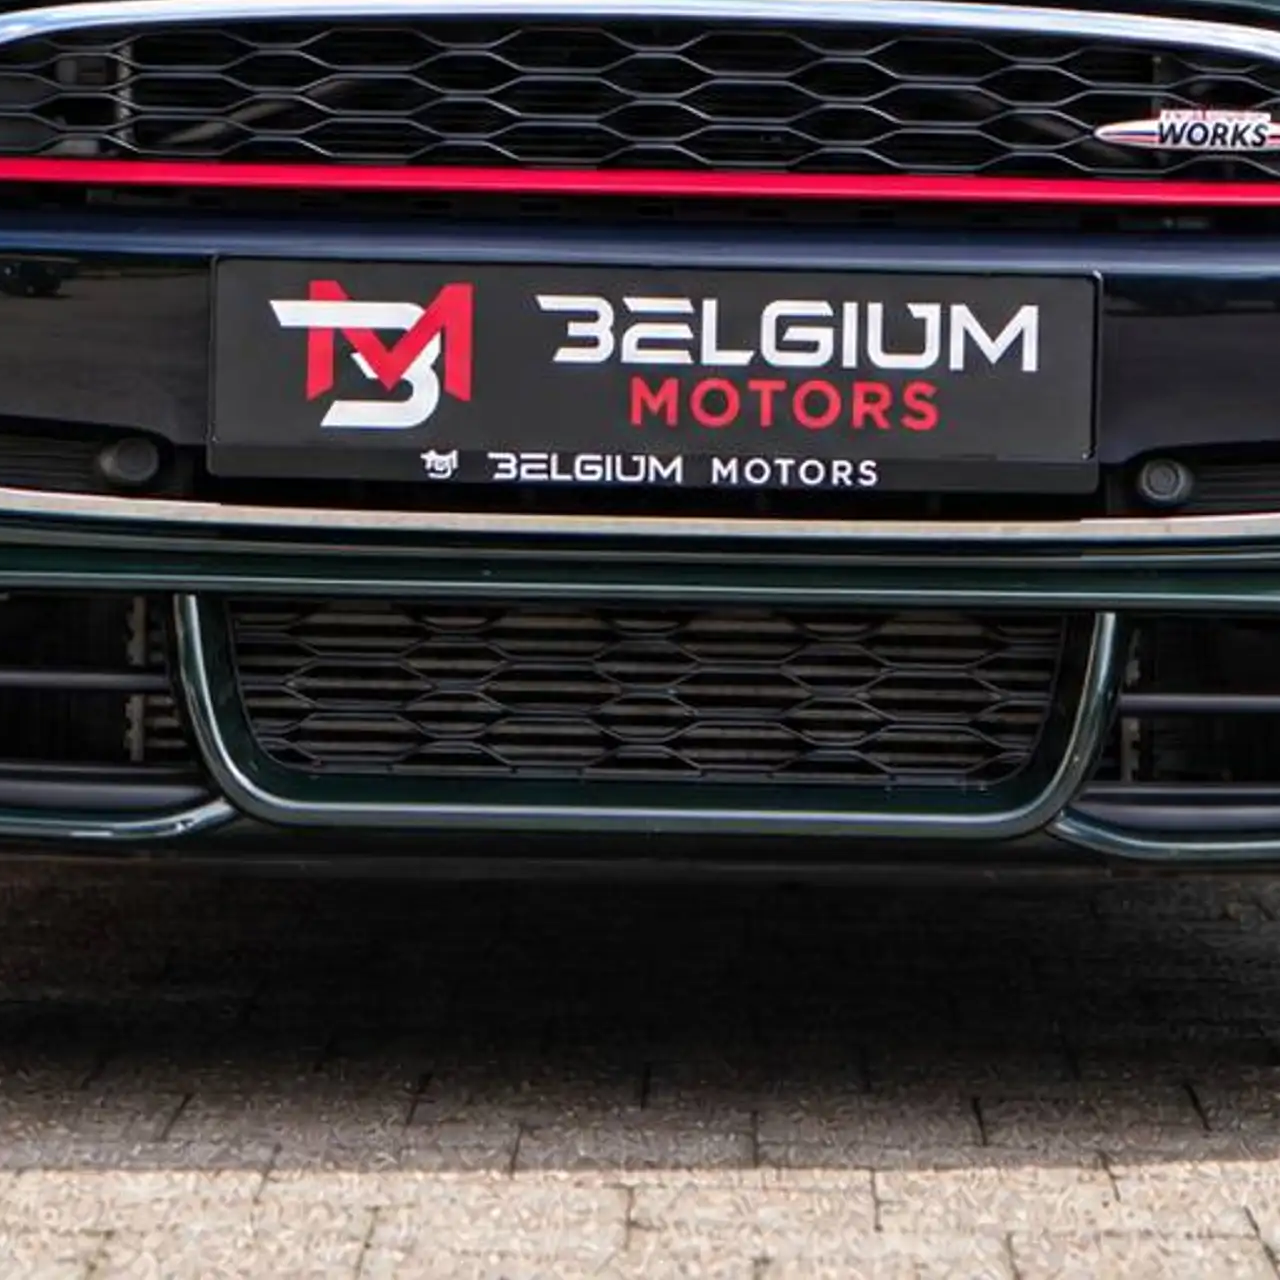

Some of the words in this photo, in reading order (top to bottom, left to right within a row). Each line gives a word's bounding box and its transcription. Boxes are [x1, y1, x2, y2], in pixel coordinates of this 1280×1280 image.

[1158, 122, 1270, 148] WORKS
[536, 294, 1040, 372] BELGIUM
[629, 375, 940, 432] MOTORS
[487, 451, 683, 484] BELGIUM
[711, 457, 878, 487] MOTORS
